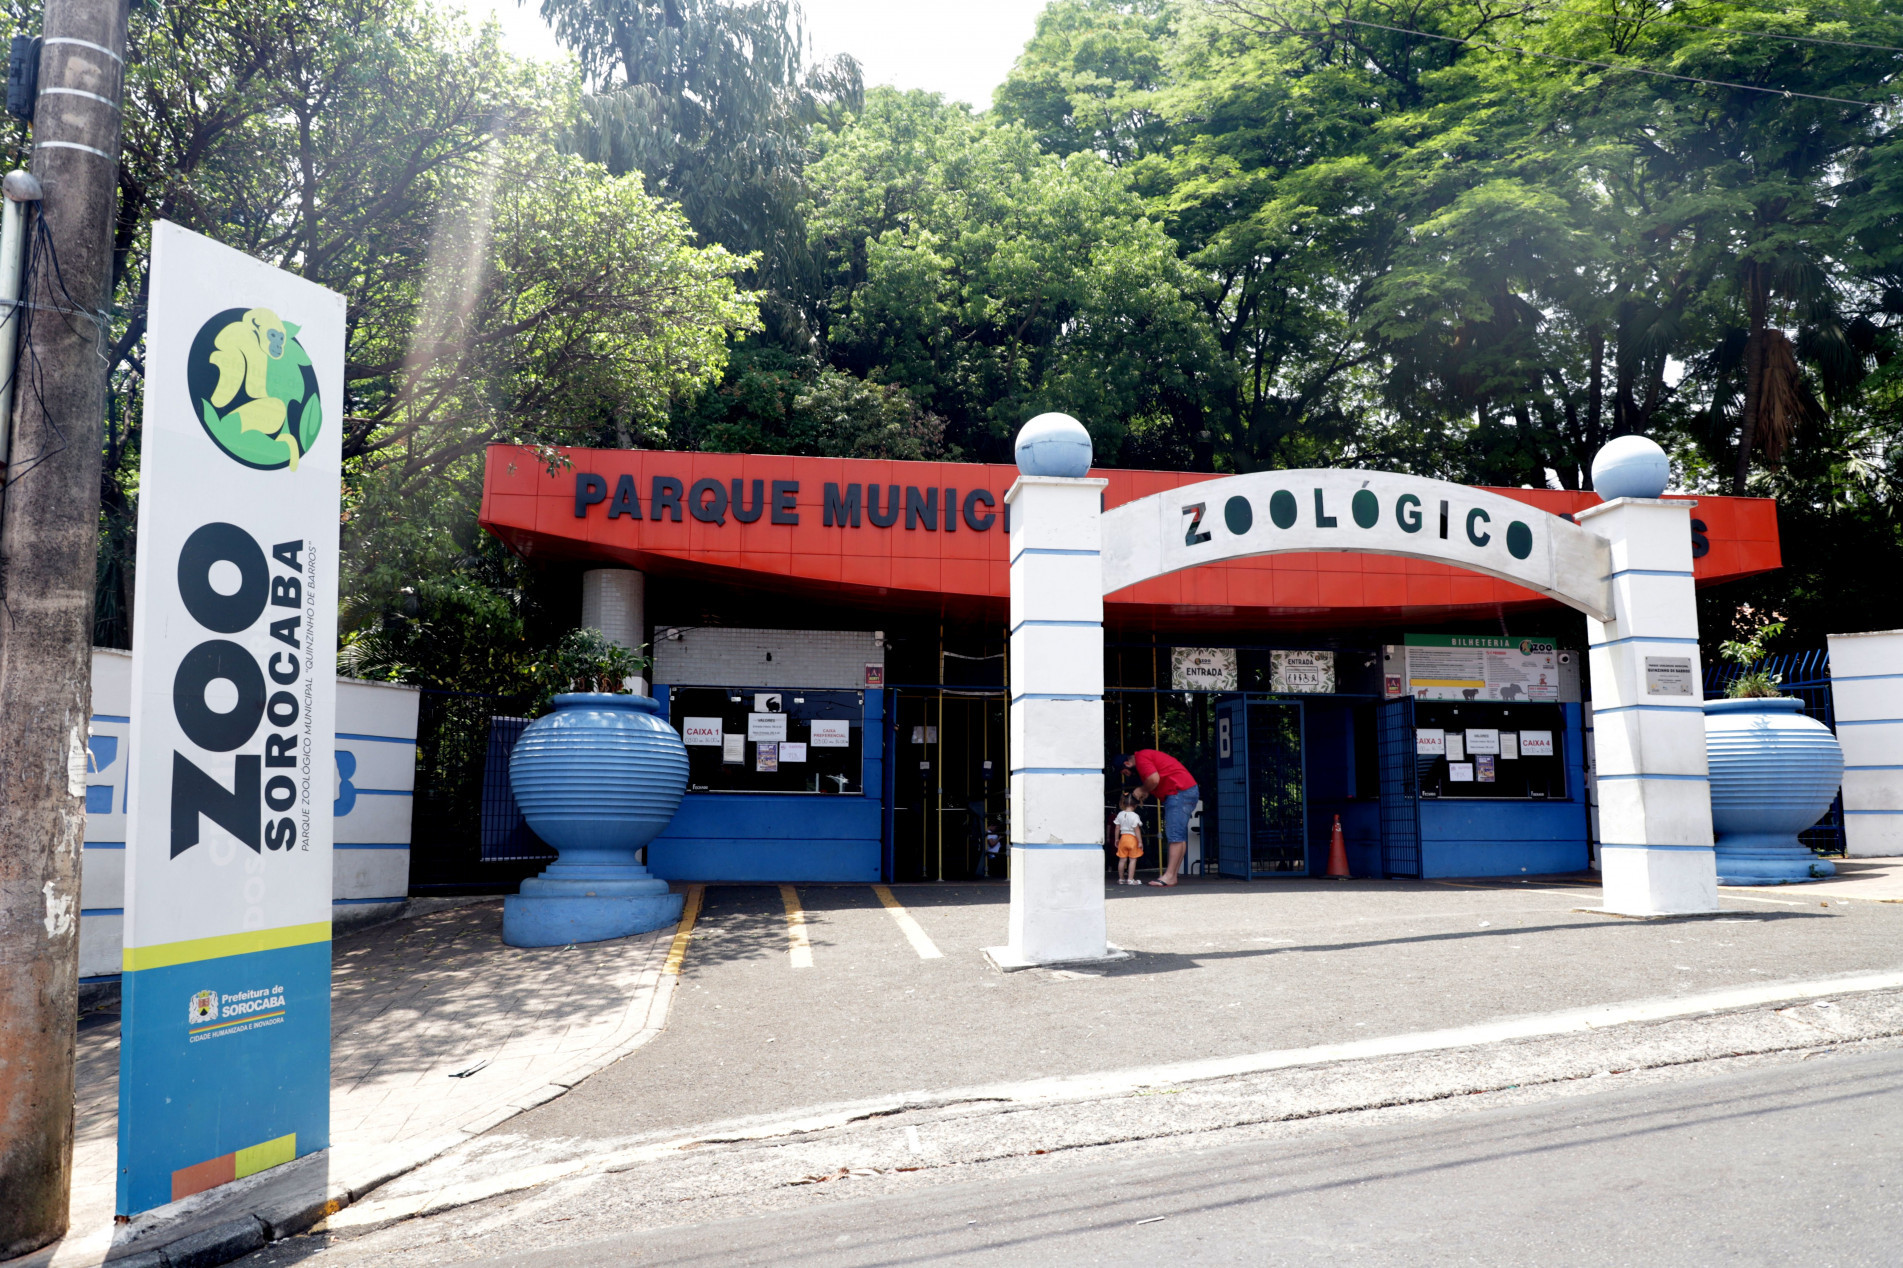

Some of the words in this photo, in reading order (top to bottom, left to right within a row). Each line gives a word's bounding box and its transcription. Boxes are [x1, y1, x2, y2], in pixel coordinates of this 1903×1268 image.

[574, 472, 800, 527] PARQUE
[1181, 480, 1533, 560] ZOOLÓGICO
[307, 591, 316, 606] DE
[1451, 637, 1510, 648] BILHETERIA
[1532, 643, 1553, 652] ZOO
[1186, 667, 1223, 677] ENTRADA
[170, 521, 270, 861] ZOO
[264, 539, 304, 852] SOROCABA
[304, 677, 313, 735] MUNICIPAL
[686, 728, 713, 736] CAIXA
[715, 728, 719, 736] 1
[1219, 717, 1231, 759] B
[301, 738, 312, 806] ZOOLÓGICO
[301, 808, 310, 852] PARQUE
[222, 989, 269, 1004] Prefeitura
[272, 984, 284, 995] de
[222, 995, 285, 1017] SOROCABA
[189, 1033, 211, 1043] CIDADE
[212, 1024, 248, 1037] HUMANIZADA
[254, 1017, 284, 1028] INOVADORA
